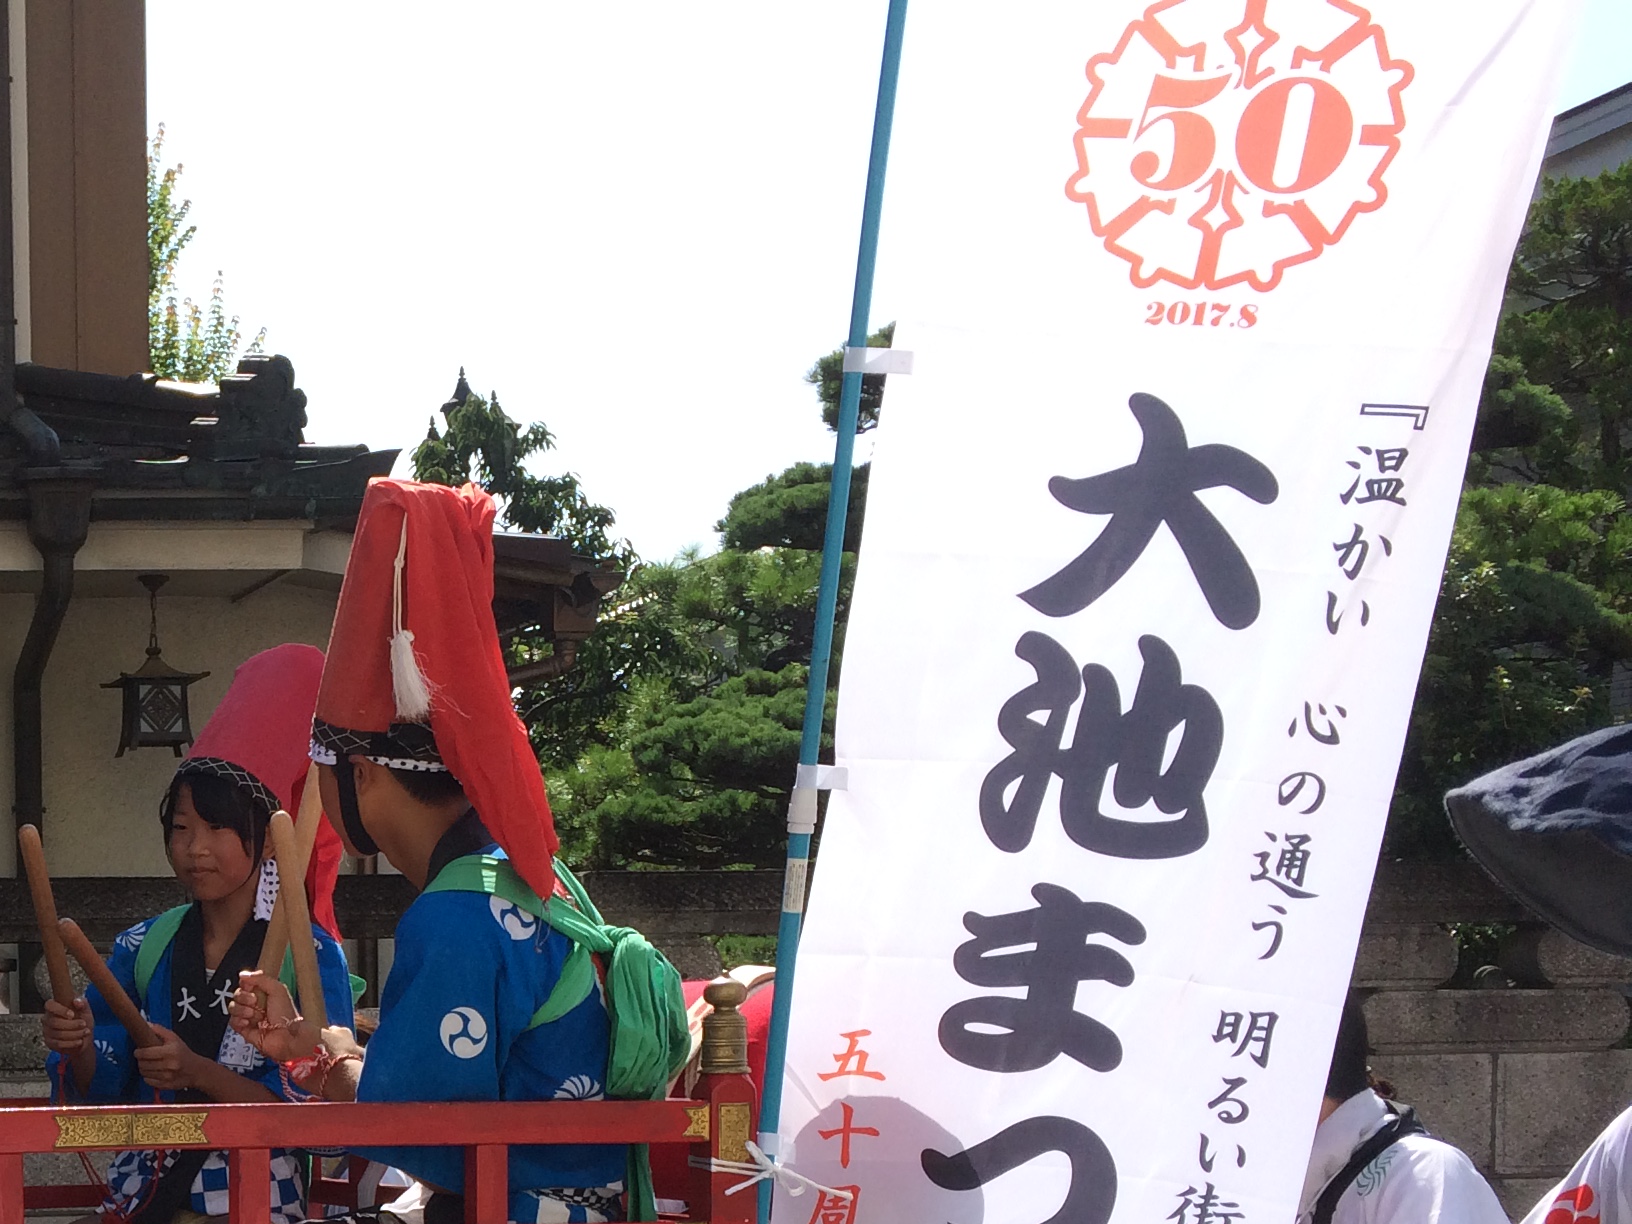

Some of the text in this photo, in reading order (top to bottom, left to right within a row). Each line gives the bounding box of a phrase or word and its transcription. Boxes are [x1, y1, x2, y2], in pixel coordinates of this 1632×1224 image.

[1129, 66, 1355, 195] 50
[1143, 300, 1259, 330] 2017.8
[1325, 402, 1430, 636] 『温かい
[1251, 699, 1348, 961] 心の通う
[176, 986, 202, 1023] 大
